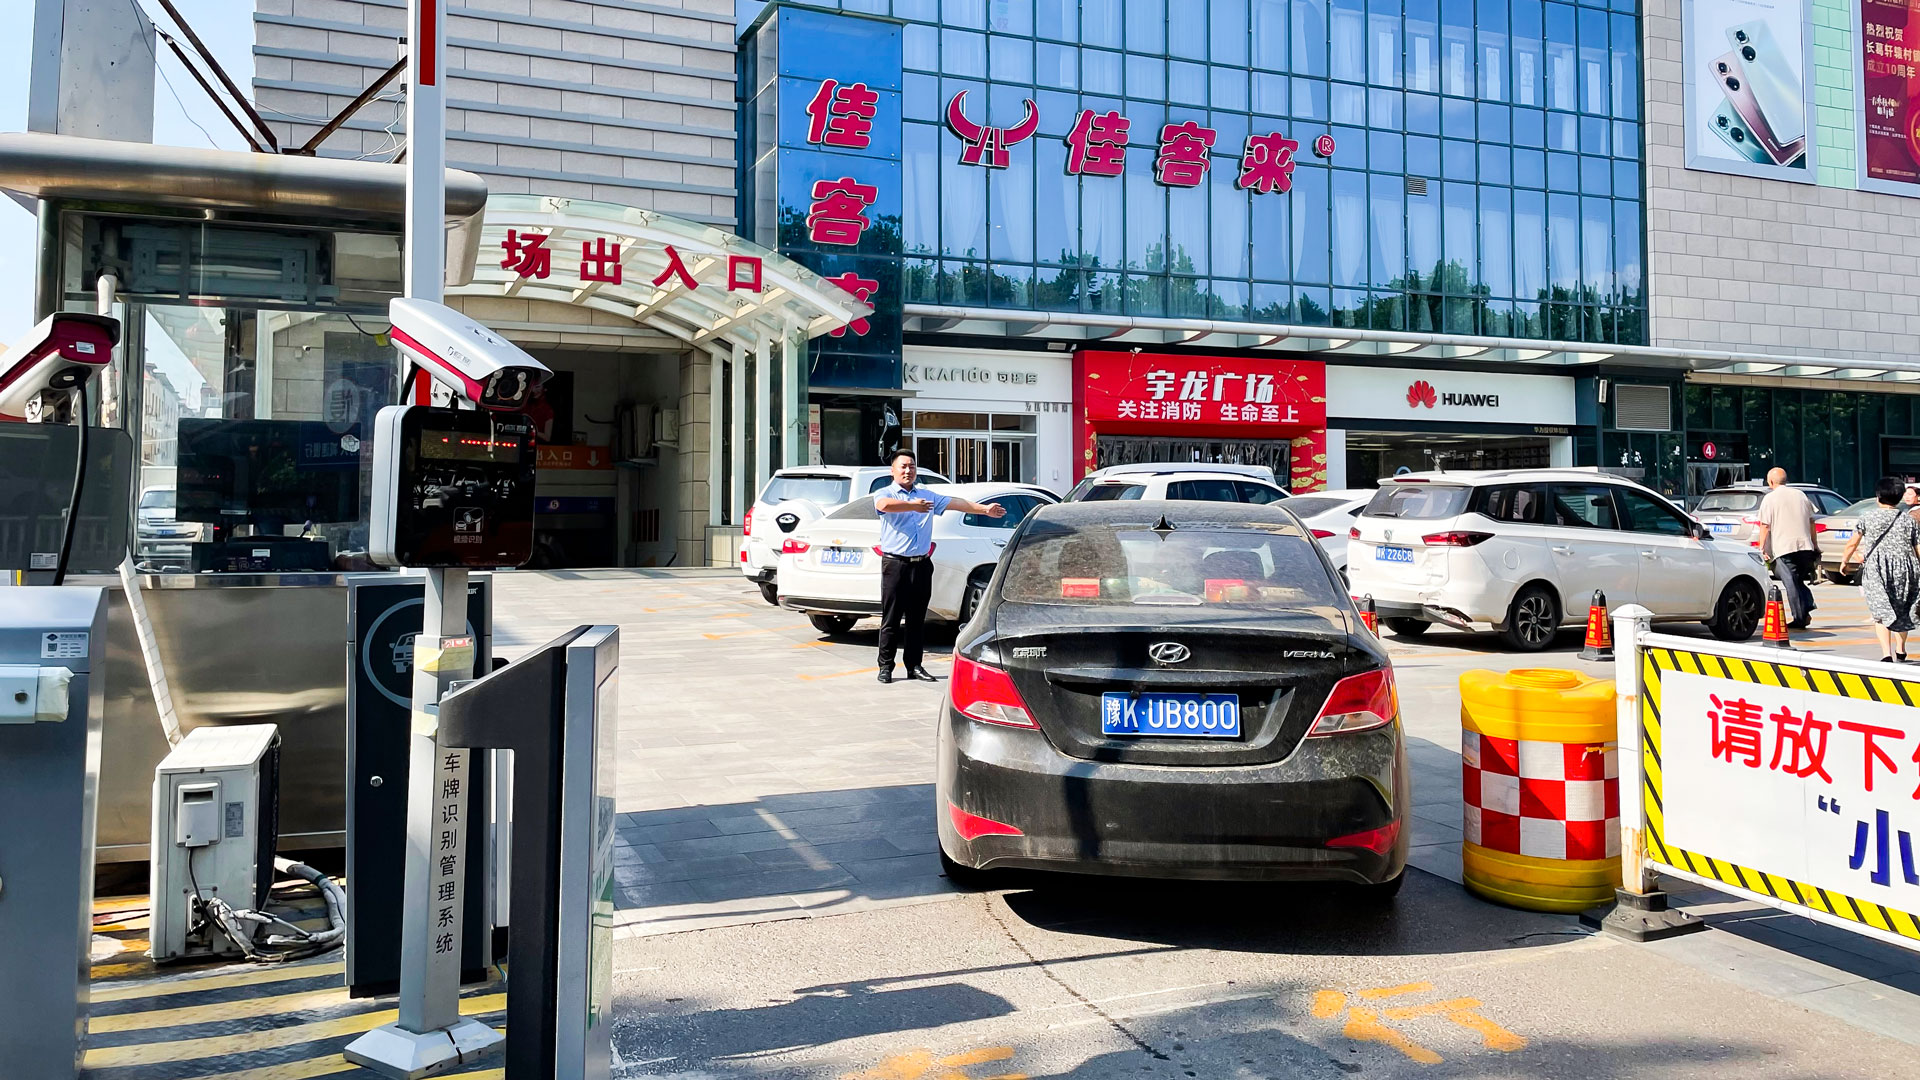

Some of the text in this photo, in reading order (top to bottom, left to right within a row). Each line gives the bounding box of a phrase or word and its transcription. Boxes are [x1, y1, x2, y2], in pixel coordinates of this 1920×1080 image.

[1866, 22, 1903, 42] 热烈祝贺
[1866, 59, 1916, 79] 成立10周年
[1066, 110, 1298, 194] 佳客来
[806, 78, 879, 338] 佳客来
[501, 229, 762, 294] 场出入口
[1146, 370, 1275, 404] 宇龙广场
[1442, 392, 1499, 408] HUAWEI
[1117, 400, 1300, 423] 关注消防 生命至上
[1705, 444, 1713, 456] 4
[1283, 650, 1336, 660] VERNA
[1105, 698, 1236, 730] 豫K·UB800
[1707, 692, 1920, 802] 请放下
[435, 753, 461, 954] 车牌识别管理系统
